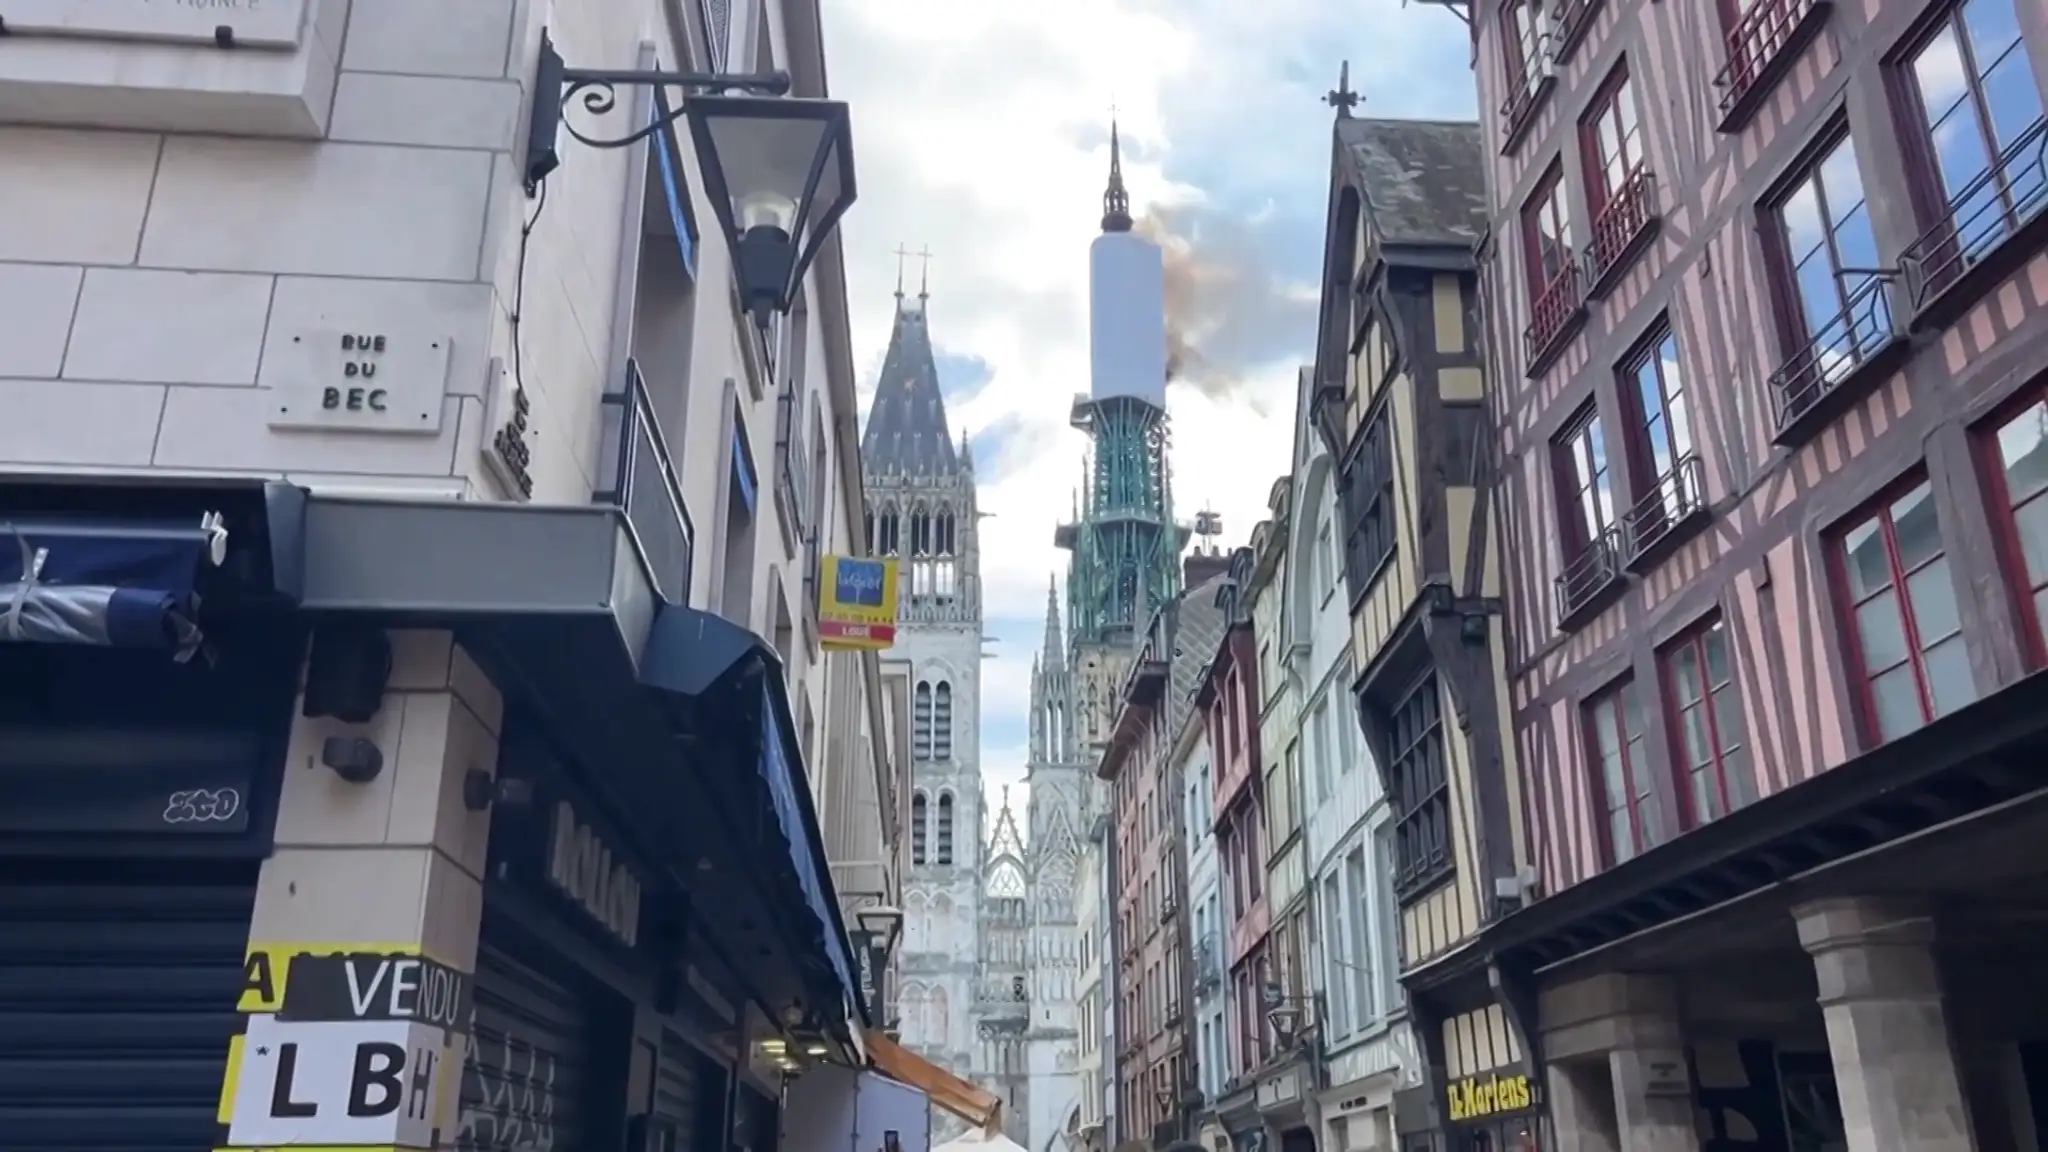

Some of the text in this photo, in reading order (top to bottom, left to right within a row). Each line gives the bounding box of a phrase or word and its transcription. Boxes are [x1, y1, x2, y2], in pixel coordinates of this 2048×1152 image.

[342, 334, 386, 352] RUE
[344, 361, 376, 378] DU
[322, 386, 387, 411] BEC
[344, 959, 461, 1026] VENDU
